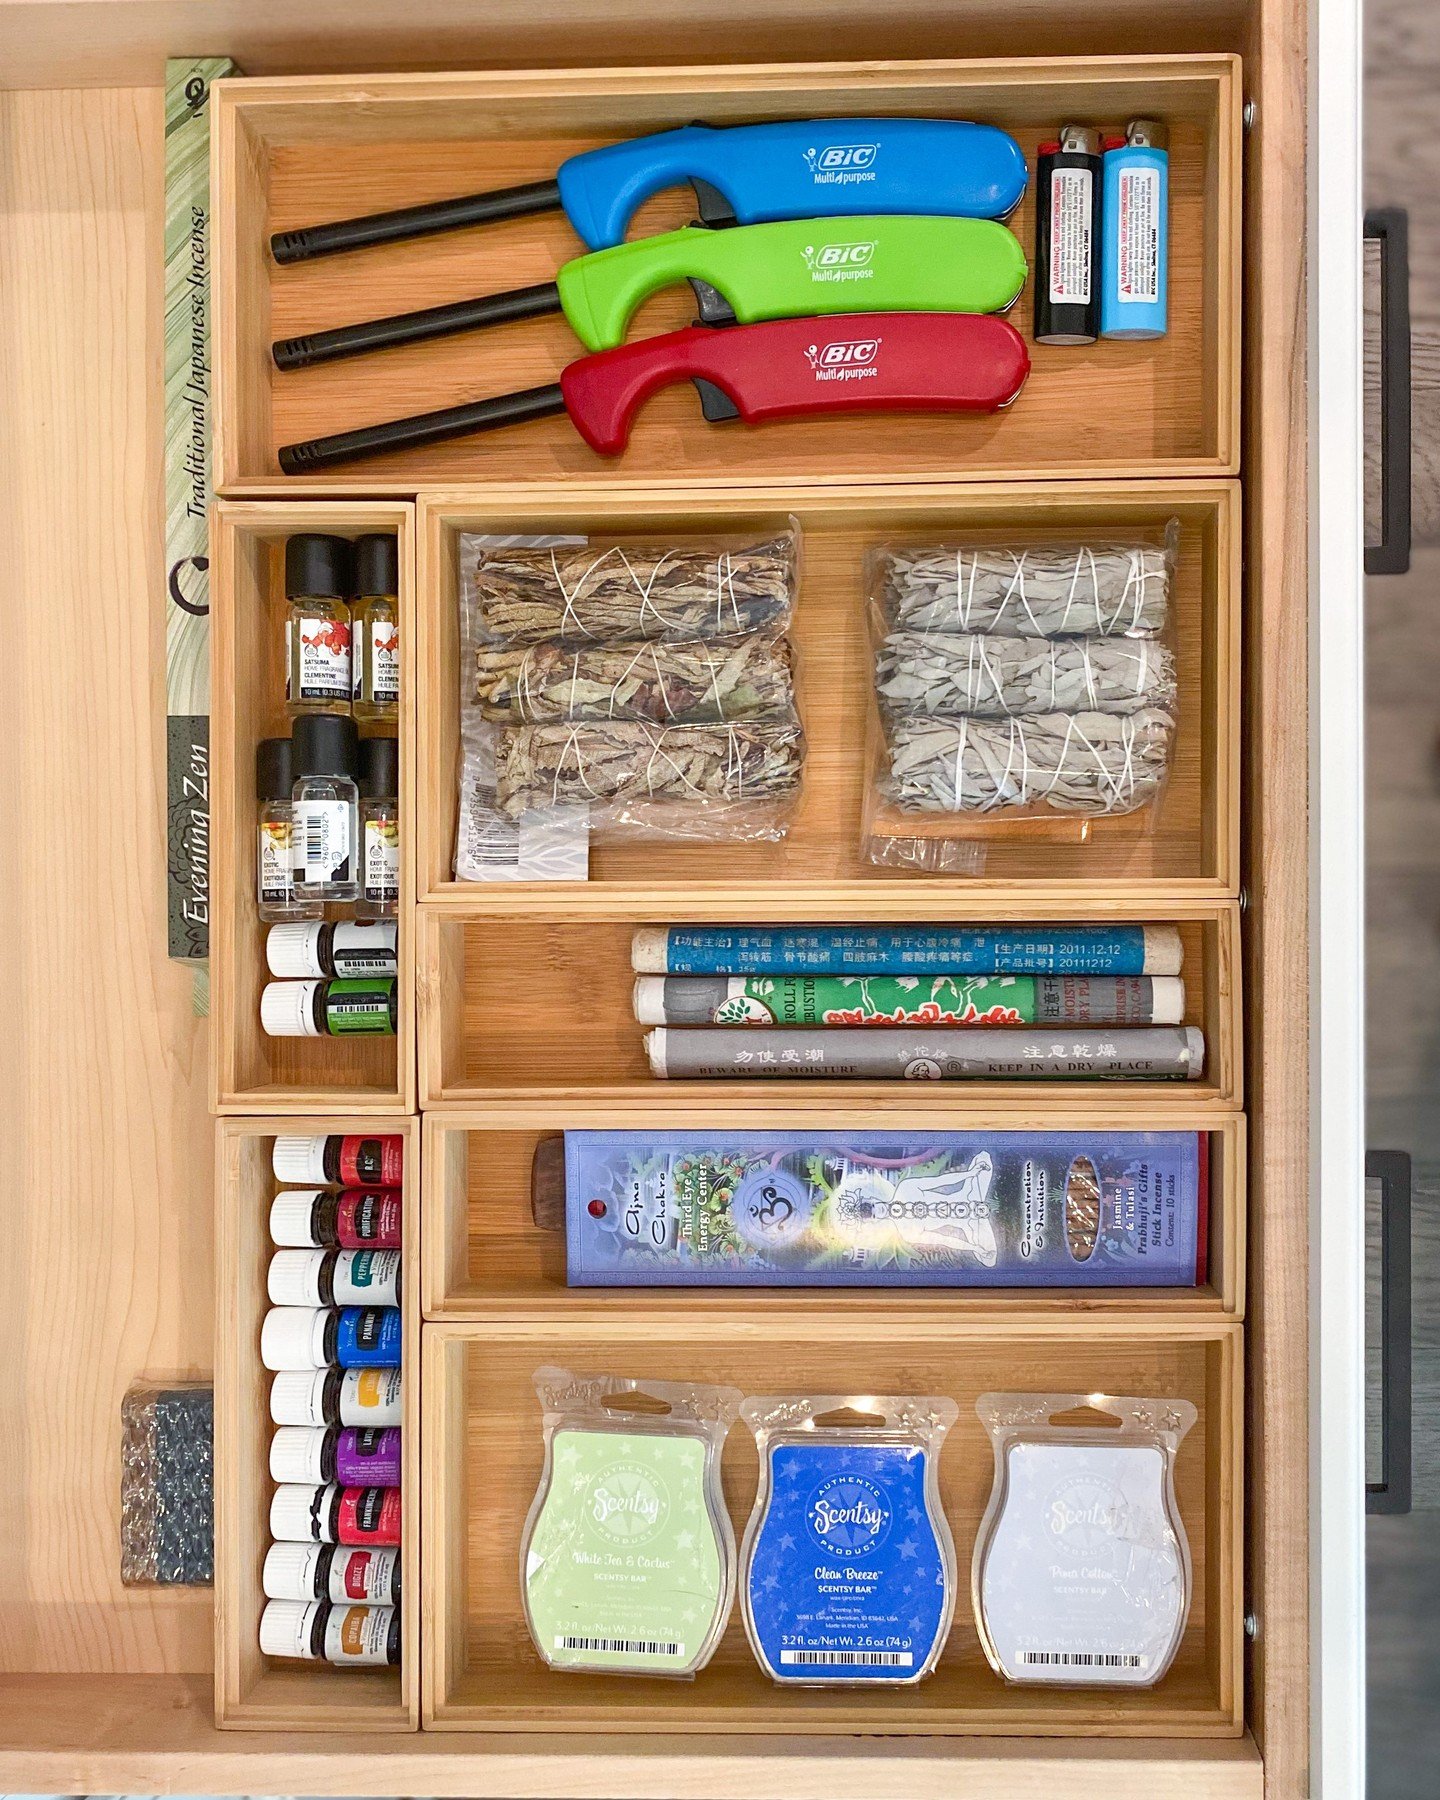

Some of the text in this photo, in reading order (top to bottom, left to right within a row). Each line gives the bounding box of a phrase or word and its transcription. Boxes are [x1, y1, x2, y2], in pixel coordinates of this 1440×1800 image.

[1120, 245, 1128, 285] WARNING
[182, 206, 211, 520] Traditional Japanese Incense
[182, 744, 210, 924] Evening Zen
[994, 943, 1121, 955] 【生产日期】 2011.12.12
[994, 958, 1113, 968] 【产品批号】 20111212
[784, 989, 796, 1019] ROLL
[733, 1049, 824, 1063] 勿使受潮
[787, 1065, 857, 1073] MOISTURE
[989, 1061, 1153, 1072] KEEP IN A DRY PLACE
[1034, 1170, 1045, 1232] Intuition
[1165, 1174, 1175, 1197] sticks
[361, 1197, 375, 1237] PURIFICATION
[625, 1182, 643, 1235] Ajna
[651, 1171, 666, 1245] Chakra
[682, 1178, 694, 1238] Third Eye
[697, 1163, 711, 1252] Energy Center
[1021, 1161, 1031, 1258] Concentration
[1112, 1187, 1123, 1230] Jasmine
[1125, 1186, 1135, 1231] & Tulasi
[1137, 1163, 1150, 1255] Prabhuji's Gifts
[1151, 1171, 1162, 1247] Stick Incense
[1165, 1197, 1174, 1208] 10
[597, 1465, 659, 1487] AUTHENTIC
[818, 1476, 881, 1497] AUTHENTIC
[592, 1487, 660, 1525] Scentsy
[814, 1500, 882, 1535] Scentsy
[572, 1551, 670, 1569] White Tea & Cactus
[820, 1539, 877, 1556] PRODUCT
[593, 1573, 647, 1582] SCENTSY BAR
[814, 1566, 879, 1581] Clean Breeze
[817, 1585, 872, 1594] SCENTSY BAR
[781, 1635, 796, 1645] 3.2
[797, 1635, 806, 1645] fl.
[839, 1636, 857, 1646] Wt.
[857, 1636, 873, 1646] 2.6
[886, 1635, 901, 1647] (74
[901, 1636, 912, 1649] g)
